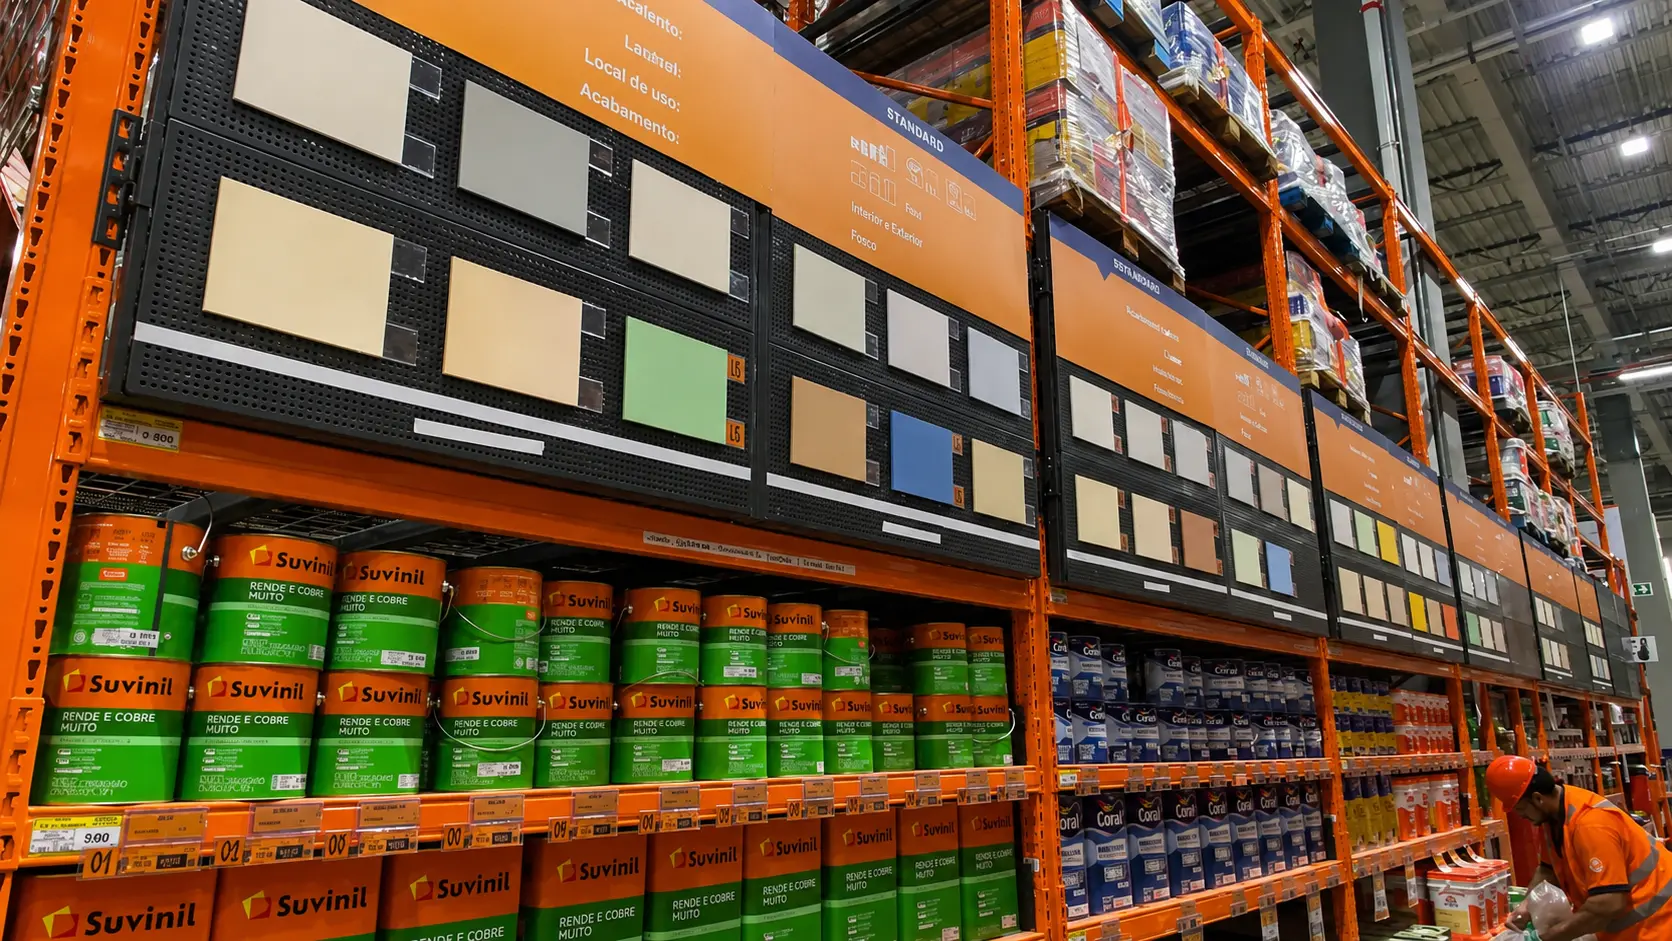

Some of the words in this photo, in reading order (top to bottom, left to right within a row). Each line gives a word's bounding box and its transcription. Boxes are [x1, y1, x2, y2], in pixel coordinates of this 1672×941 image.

[585, 47, 626, 82] Local
[630, 75, 648, 94] de
[651, 88, 680, 112] uso:
[580, 83, 680, 144] Acabamento:
[887, 107, 944, 152] STANDARD
[851, 201, 883, 227] Interior
[885, 221, 889, 230] e
[892, 223, 923, 247] Exterior
[851, 229, 877, 251] Fosco
[276, 551, 334, 576] Suvinil
[359, 565, 425, 586] Suvinil
[248, 591, 284, 602] MUITO
[250, 581, 286, 593] RENDE
[289, 584, 295, 593] E
[297, 586, 324, 598] COBRE
[369, 595, 375, 603] E
[376, 595, 408, 606] COBRE
[568, 594, 611, 609] Suvinil
[774, 614, 814, 625] Suvinil
[89, 674, 172, 695] Suvinil
[230, 681, 304, 700] Suvinil
[361, 686, 422, 705] Suvinil
[472, 690, 529, 707] Suvinil
[569, 695, 611, 710] Suvinil
[649, 695, 692, 709] Suvinil
[62, 711, 100, 722] RENDE
[104, 712, 112, 722] E
[115, 712, 156, 723] COBRE
[207, 714, 241, 724] RENDE
[244, 715, 251, 724] E
[254, 715, 289, 725] COBRE
[339, 717, 371, 727] RENDE
[374, 718, 381, 727] E
[382, 718, 411, 727] COBRE
[483, 719, 489, 728] E
[490, 719, 518, 728] COBRE
[60, 722, 97, 733] MUITO
[206, 724, 239, 734] MUITO
[338, 726, 370, 736] MUITO
[550, 728, 577, 737] MUITO
[1175, 803, 1195, 818] Coral
[1208, 801, 1226, 816] Coral
[1236, 798, 1252, 812] Coral
[1260, 795, 1278, 809] Coral
[1060, 813, 1080, 831] oral
[1096, 810, 1123, 828] Coral
[1138, 805, 1161, 823] Coral
[923, 822, 955, 837] Suvinil
[982, 816, 1012, 830] Suvinil
[856, 827, 893, 845] Suvinil
[220, 839, 240, 862] 01
[776, 837, 818, 857] Suvinil
[90, 850, 112, 875] 01
[688, 846, 738, 868] Suvinil
[580, 856, 640, 881] Suvinil
[846, 871, 867, 882] RENDE
[868, 869, 873, 878] E
[873, 865, 893, 877] COBRE
[437, 872, 510, 900] Suvinil
[762, 884, 788, 896] RENDE
[789, 882, 794, 892] E
[795, 878, 816, 891] COBRE
[846, 880, 867, 892] MUITO
[276, 886, 367, 917] Suvinil
[672, 897, 701, 910] RENDE
[703, 896, 709, 906] E
[709, 891, 736, 904] COBRE
[762, 894, 788, 907] MUITO
[84, 902, 196, 937] Suvinil
[559, 913, 595, 928] RENDE
[597, 912, 603, 922] E
[605, 906, 636, 921] COBRE
[672, 908, 701, 922] MUITO
[457, 932, 464, 941] E
[467, 926, 505, 941] COBRE
[558, 926, 592, 941] MUITO
